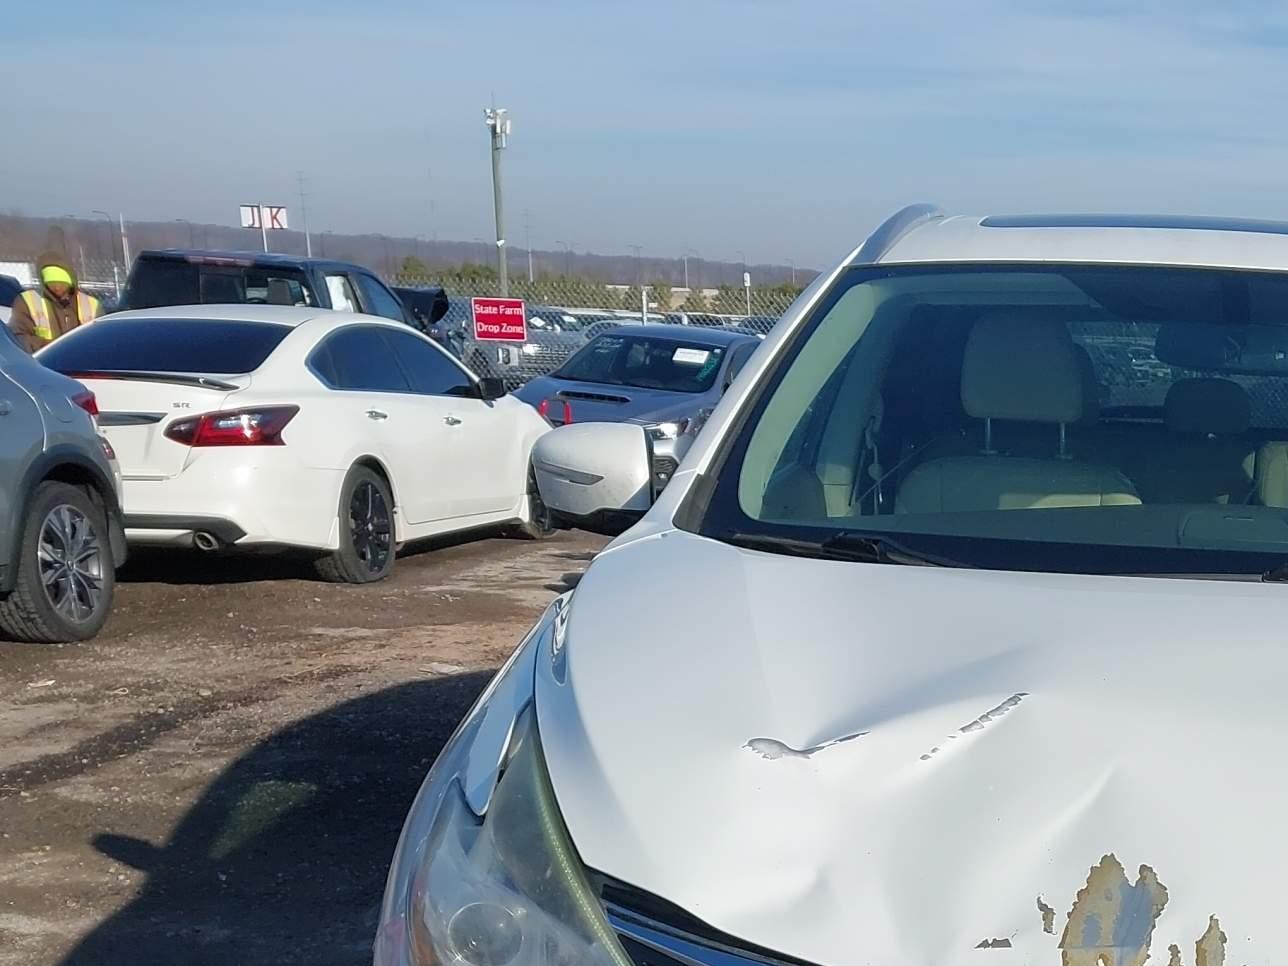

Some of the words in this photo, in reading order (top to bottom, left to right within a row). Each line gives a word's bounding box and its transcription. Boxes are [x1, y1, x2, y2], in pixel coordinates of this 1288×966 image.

[269, 207, 284, 229] K
[474, 303, 498, 314] State
[499, 304, 523, 315] Farm
[477, 321, 500, 333] Drop
[501, 322, 524, 333] Zone
